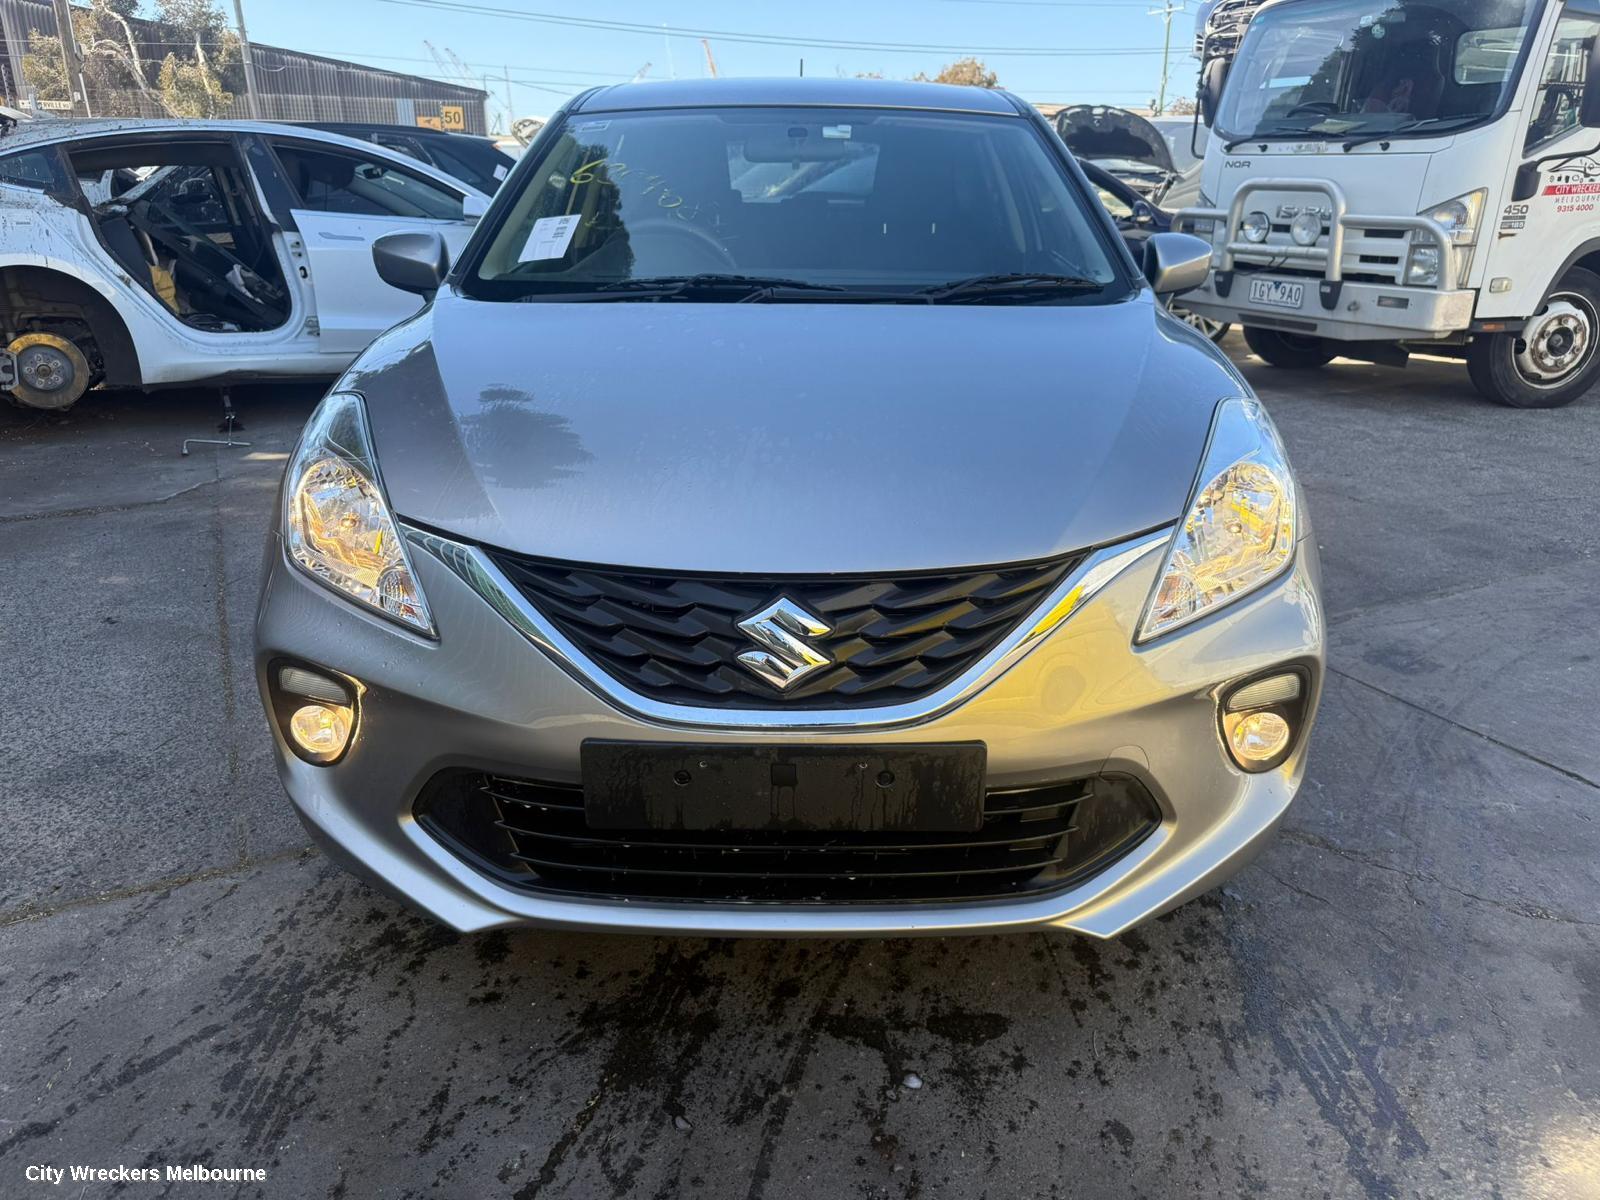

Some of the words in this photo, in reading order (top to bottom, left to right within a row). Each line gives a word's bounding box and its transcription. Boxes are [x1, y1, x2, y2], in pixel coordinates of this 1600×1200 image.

[444, 111, 461, 124] 50
[1555, 186, 1569, 194] CITY
[1555, 195, 1600, 203] MELBOURNE
[1503, 204, 1529, 215] 450
